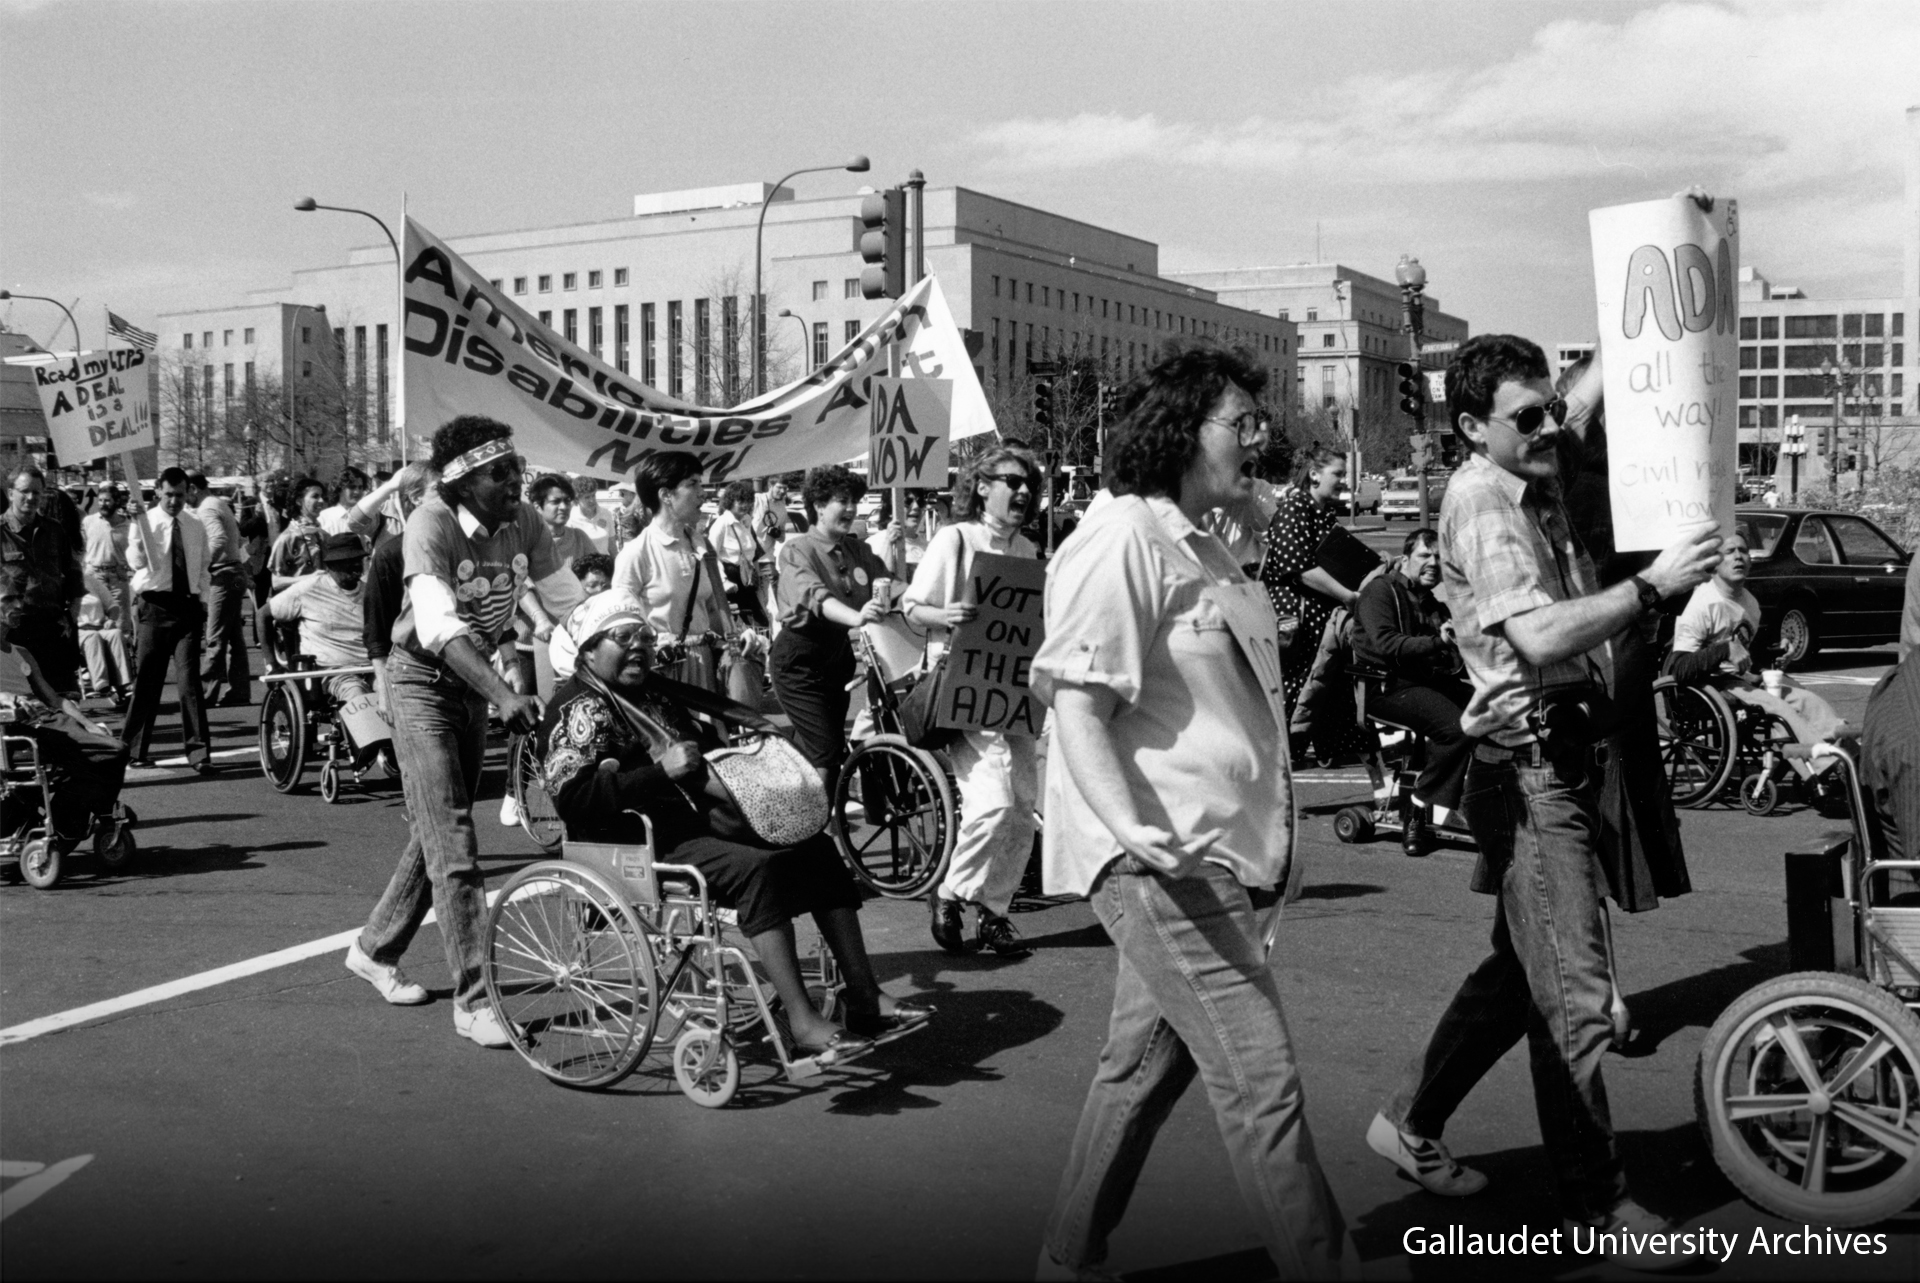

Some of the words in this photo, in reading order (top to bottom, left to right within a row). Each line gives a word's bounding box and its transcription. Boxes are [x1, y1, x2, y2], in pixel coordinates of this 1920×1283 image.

[1622, 238, 1735, 342] ADA
[35, 357, 80, 386] Read
[77, 358, 108, 384] my
[108, 349, 145, 372] LIPS
[1629, 350, 1671, 393] all
[52, 390, 74, 418] A
[75, 377, 125, 406] DEAL
[87, 405, 108, 421] is
[113, 398, 123, 411] a
[88, 401, 148, 447] DEAL!!!
[974, 576, 1043, 619] VOT
[985, 620, 1031, 647] ON
[963, 649, 1033, 688] THE
